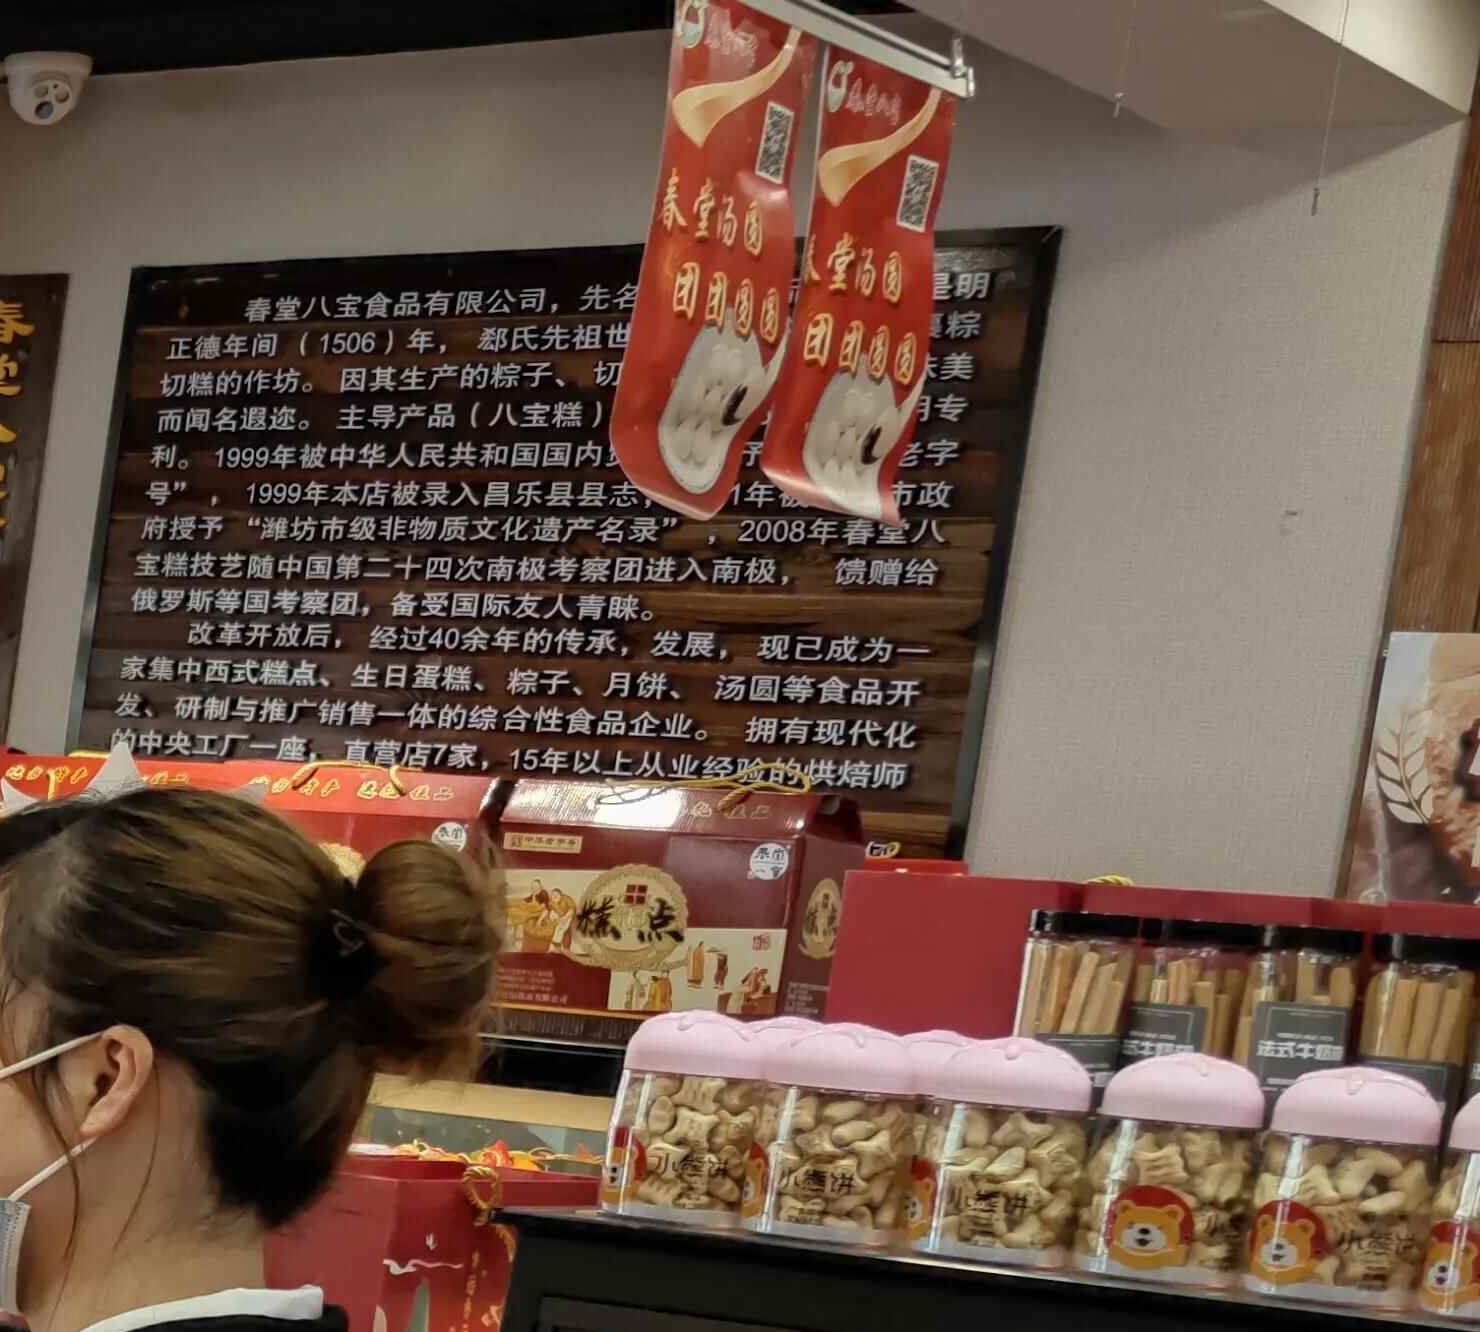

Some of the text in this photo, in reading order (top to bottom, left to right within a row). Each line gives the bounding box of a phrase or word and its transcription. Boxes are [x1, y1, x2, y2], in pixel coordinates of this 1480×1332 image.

[658, 168, 765, 256] 春堂汤圆
[672, 262, 780, 343] 团团圆圆
[803, 313, 917, 385] 团团圆圆
